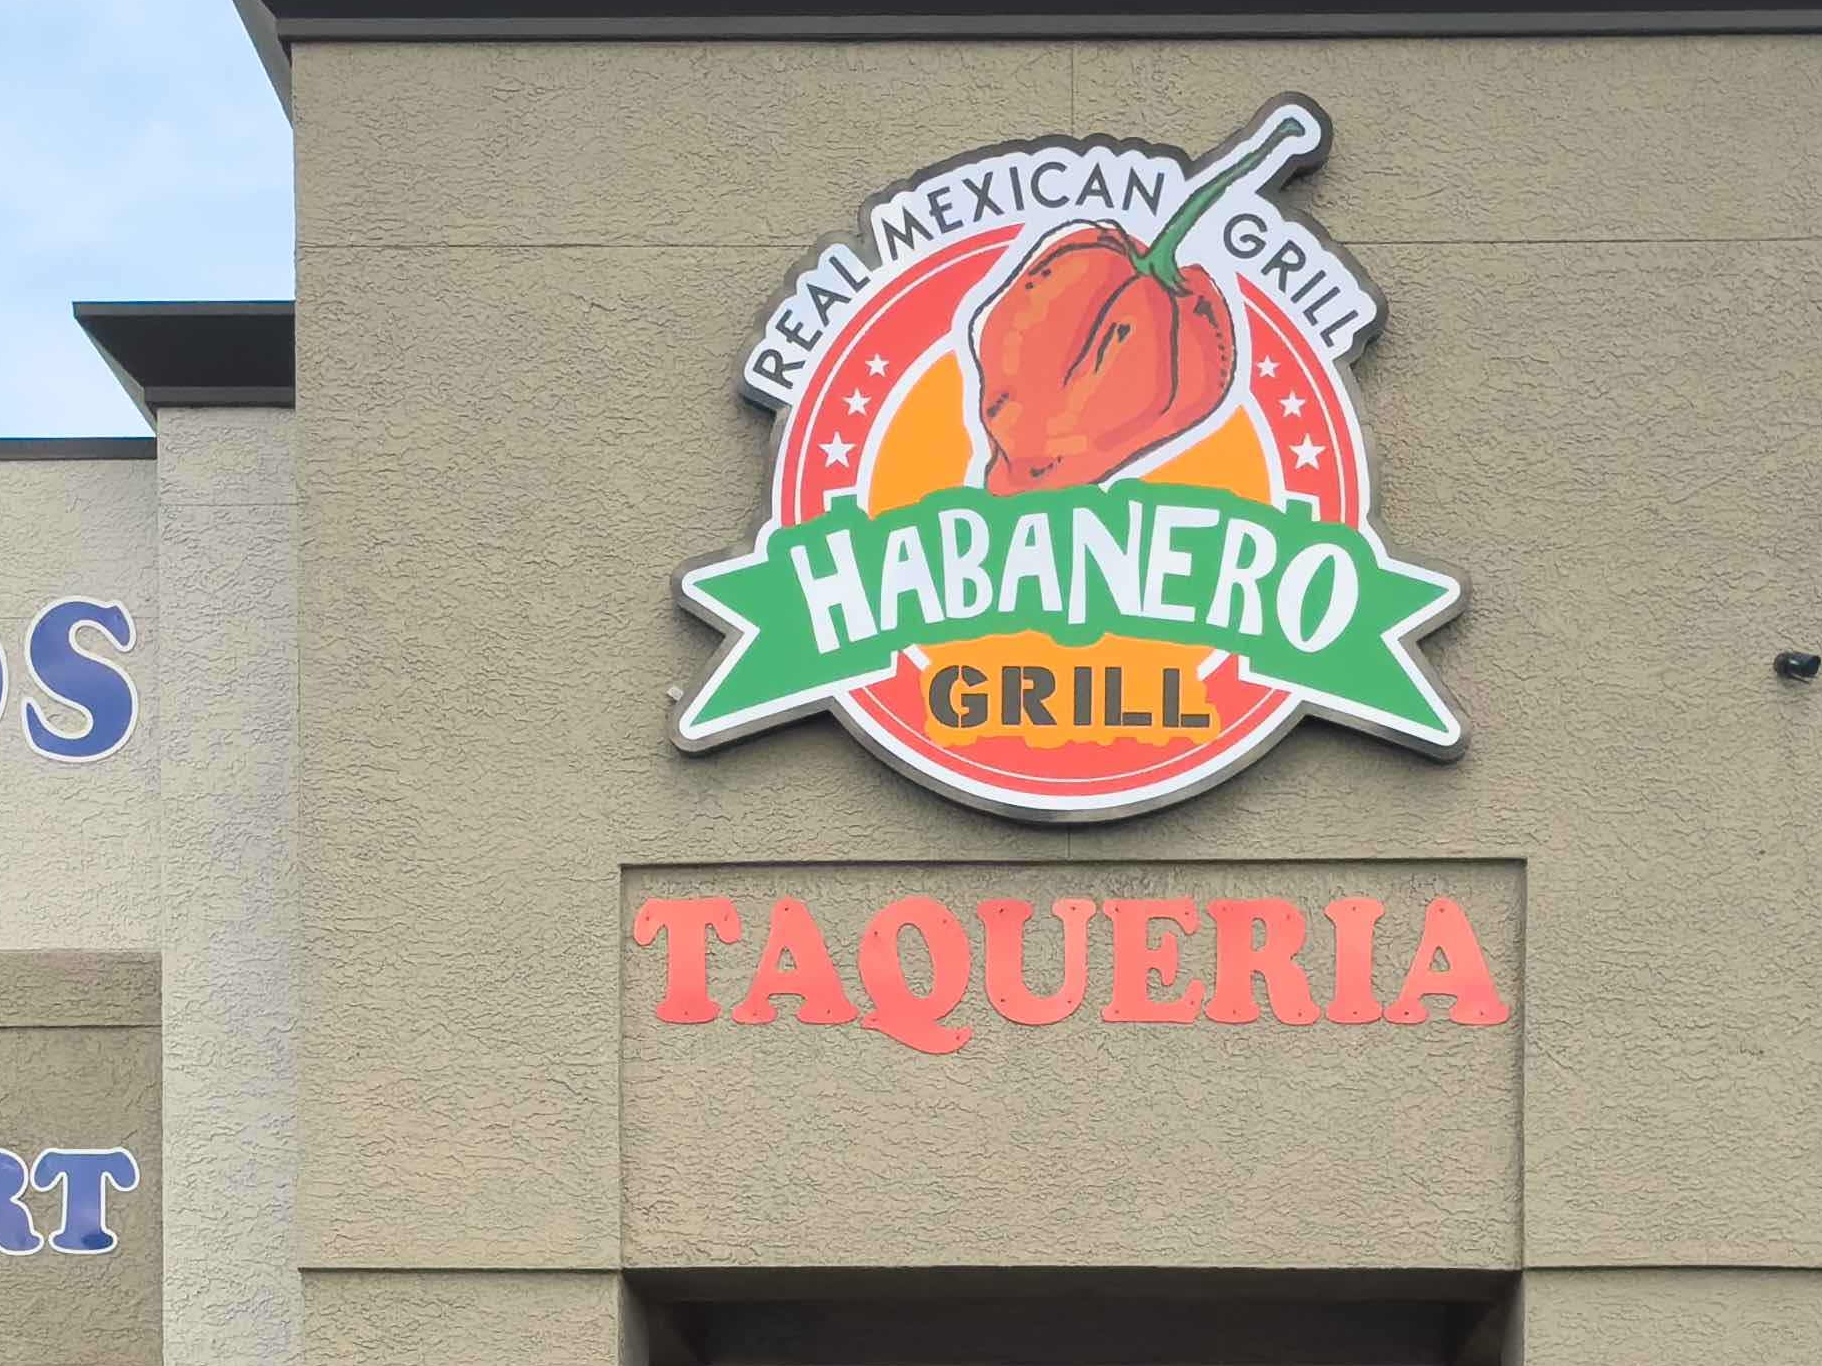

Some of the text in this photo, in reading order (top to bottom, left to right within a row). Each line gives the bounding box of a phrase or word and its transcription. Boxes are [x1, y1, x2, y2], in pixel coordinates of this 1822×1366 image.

[754, 161, 1376, 389] REAL MEXICAN GRILL
[788, 500, 1359, 654] HABANERO
[927, 665, 1211, 730] GRILL
[633, 896, 1510, 1053] TAQUERIA
